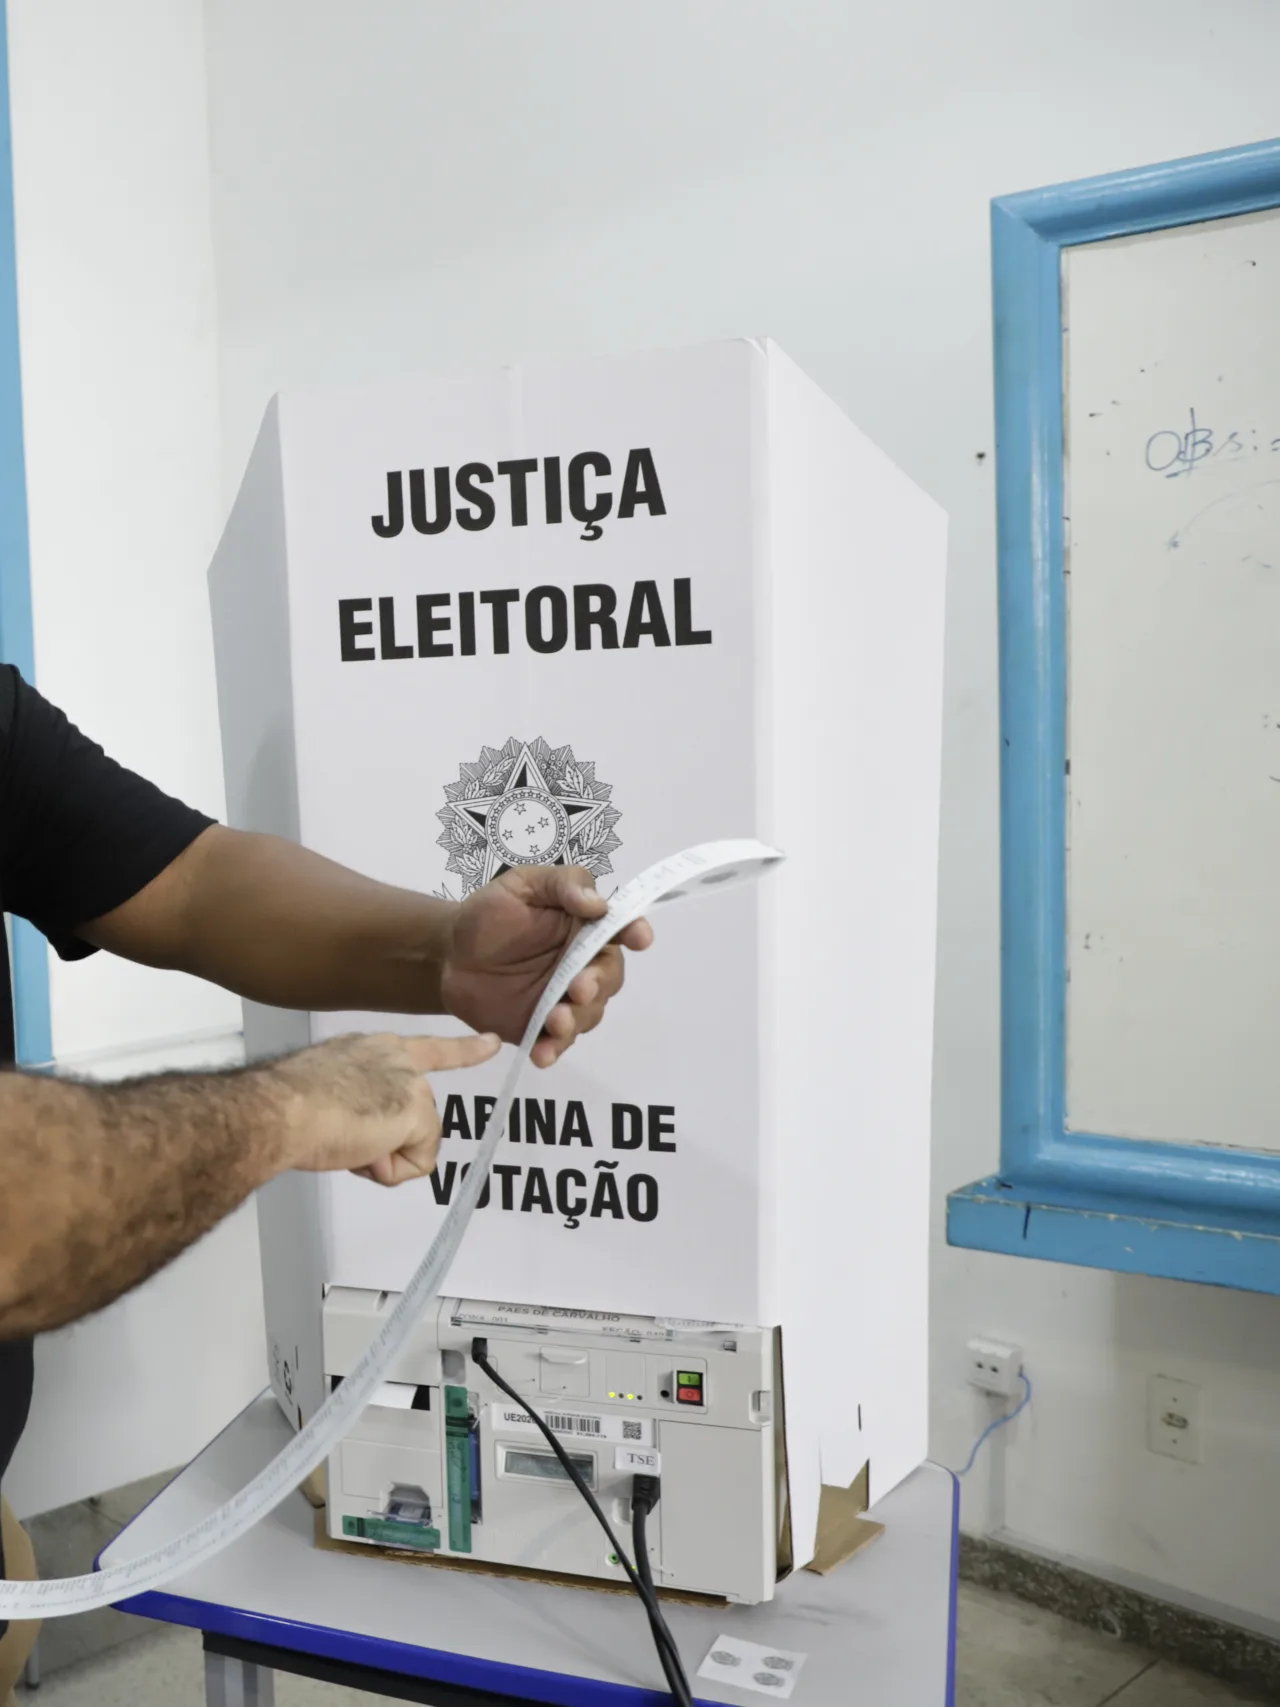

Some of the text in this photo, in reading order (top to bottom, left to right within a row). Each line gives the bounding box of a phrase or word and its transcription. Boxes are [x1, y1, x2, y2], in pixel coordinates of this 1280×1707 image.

[371, 447, 667, 541] JUSTIÇA
[338, 577, 712, 662] ELEITORAL
[433, 1093, 677, 1153] ABINA DE
[497, 1305, 530, 1316] PAES
[532, 1308, 547, 1317] DE
[552, 1310, 621, 1323] CARVALHO
[627, 1452, 656, 1467] TSE
